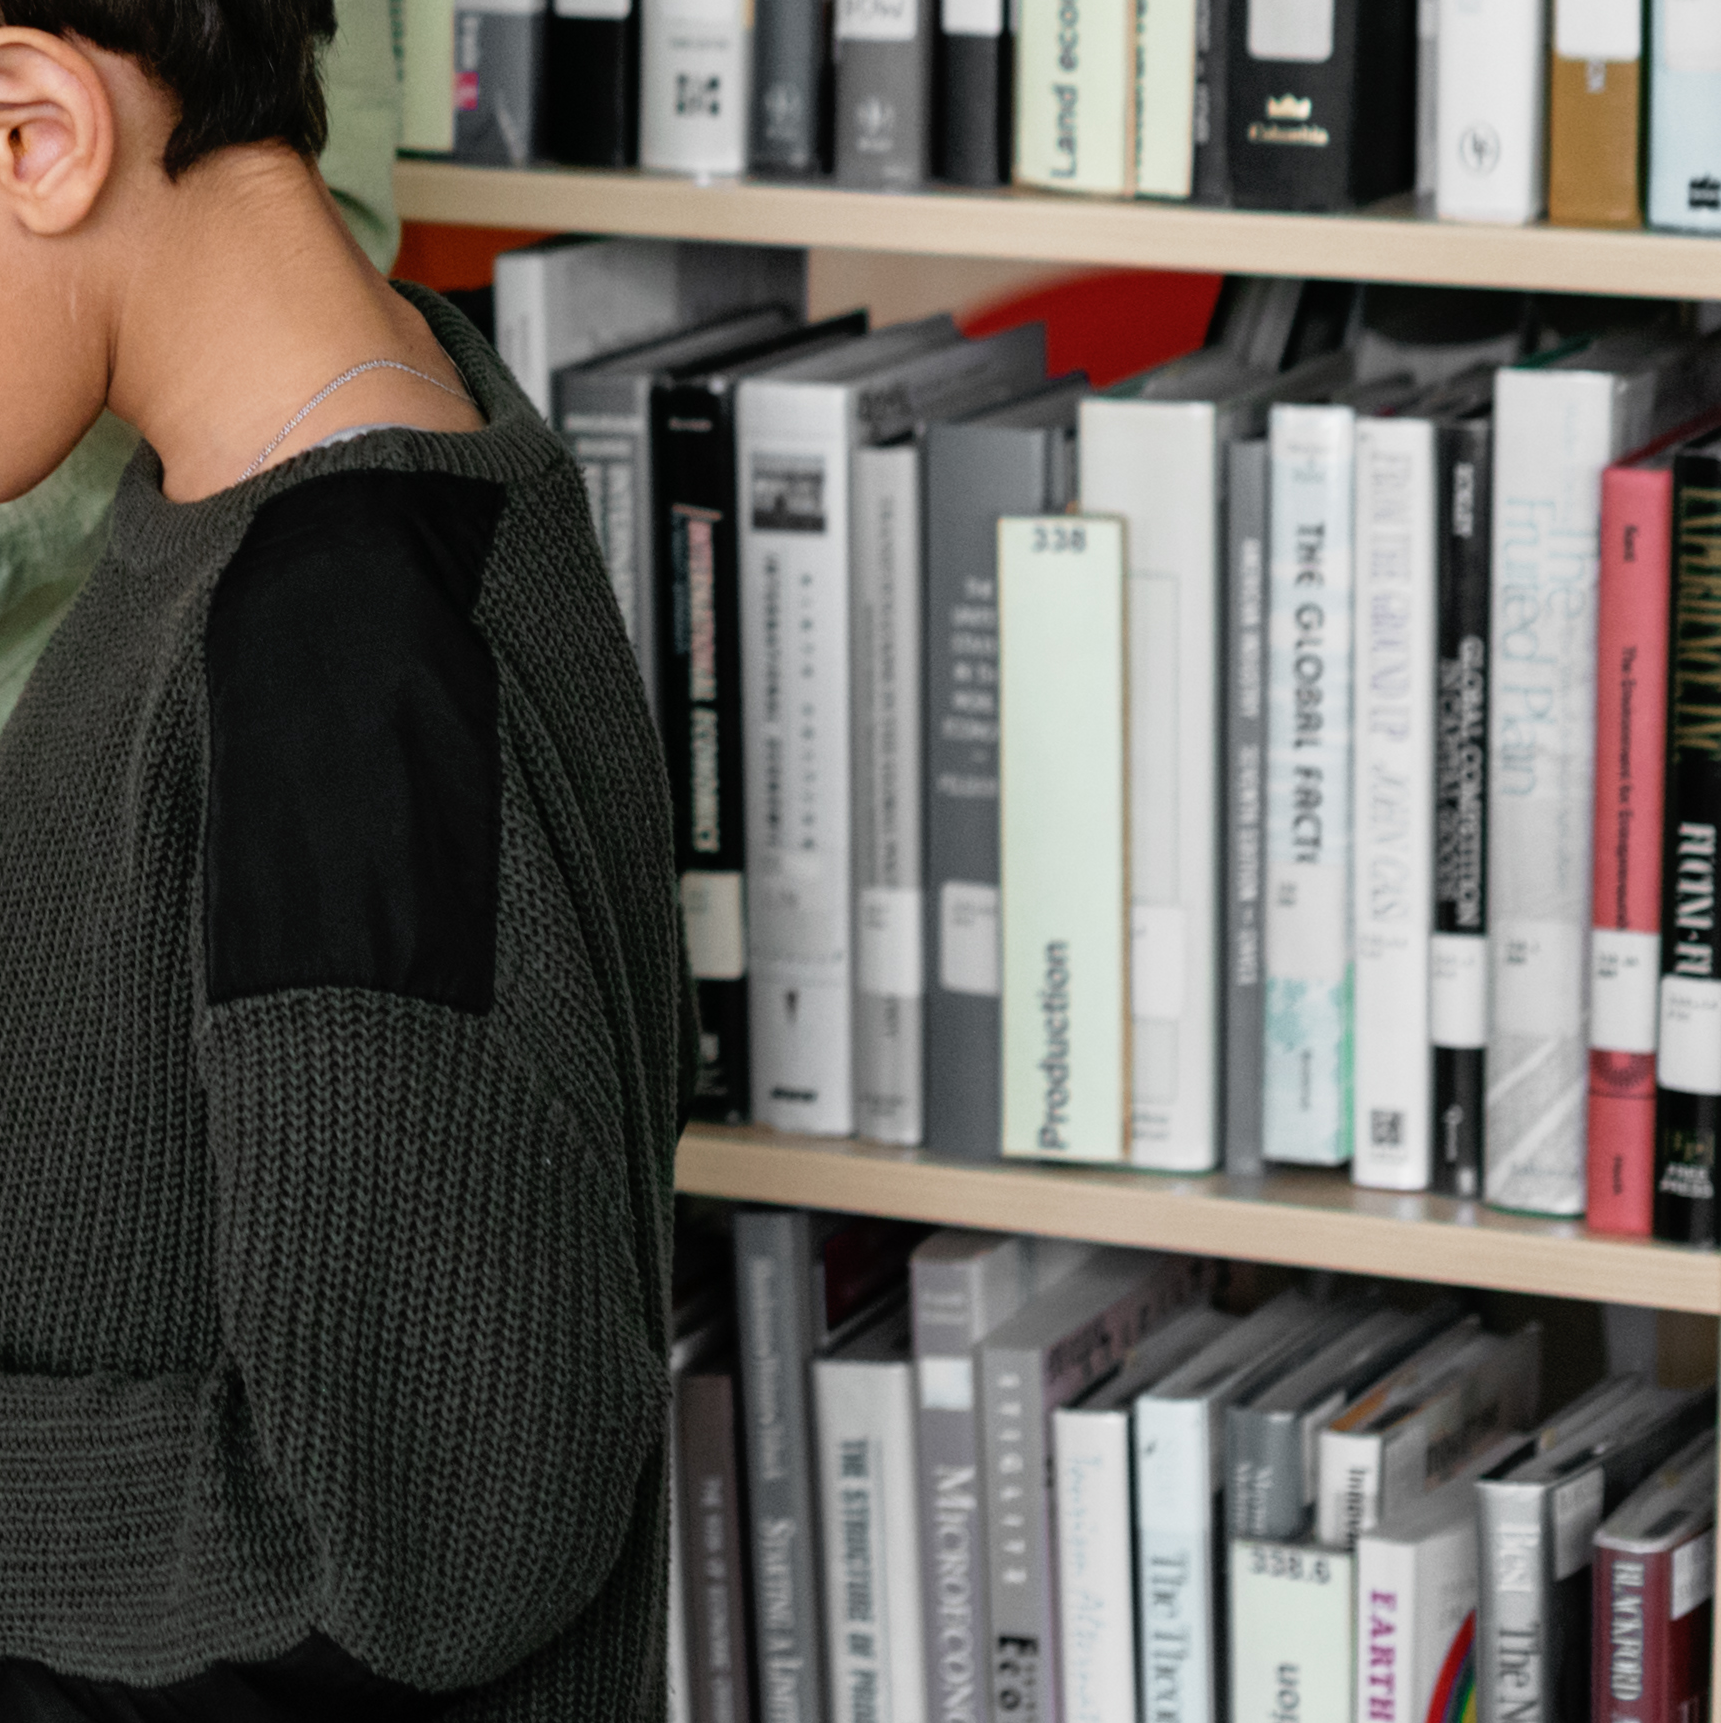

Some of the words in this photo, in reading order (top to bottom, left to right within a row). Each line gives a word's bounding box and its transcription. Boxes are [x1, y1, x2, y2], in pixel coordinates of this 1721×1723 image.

[1047, 84, 1079, 178] Land
[1031, 522, 1087, 555] 338
[1294, 522, 1323, 585] THE
[1294, 601, 1323, 747] GLOBAL
[1031, 939, 1078, 1150] Production
[1659, 1178, 1716, 1199] PRESS
[1665, 1161, 1710, 1181] FREE
[1368, 1592, 1396, 1722] EARTH
